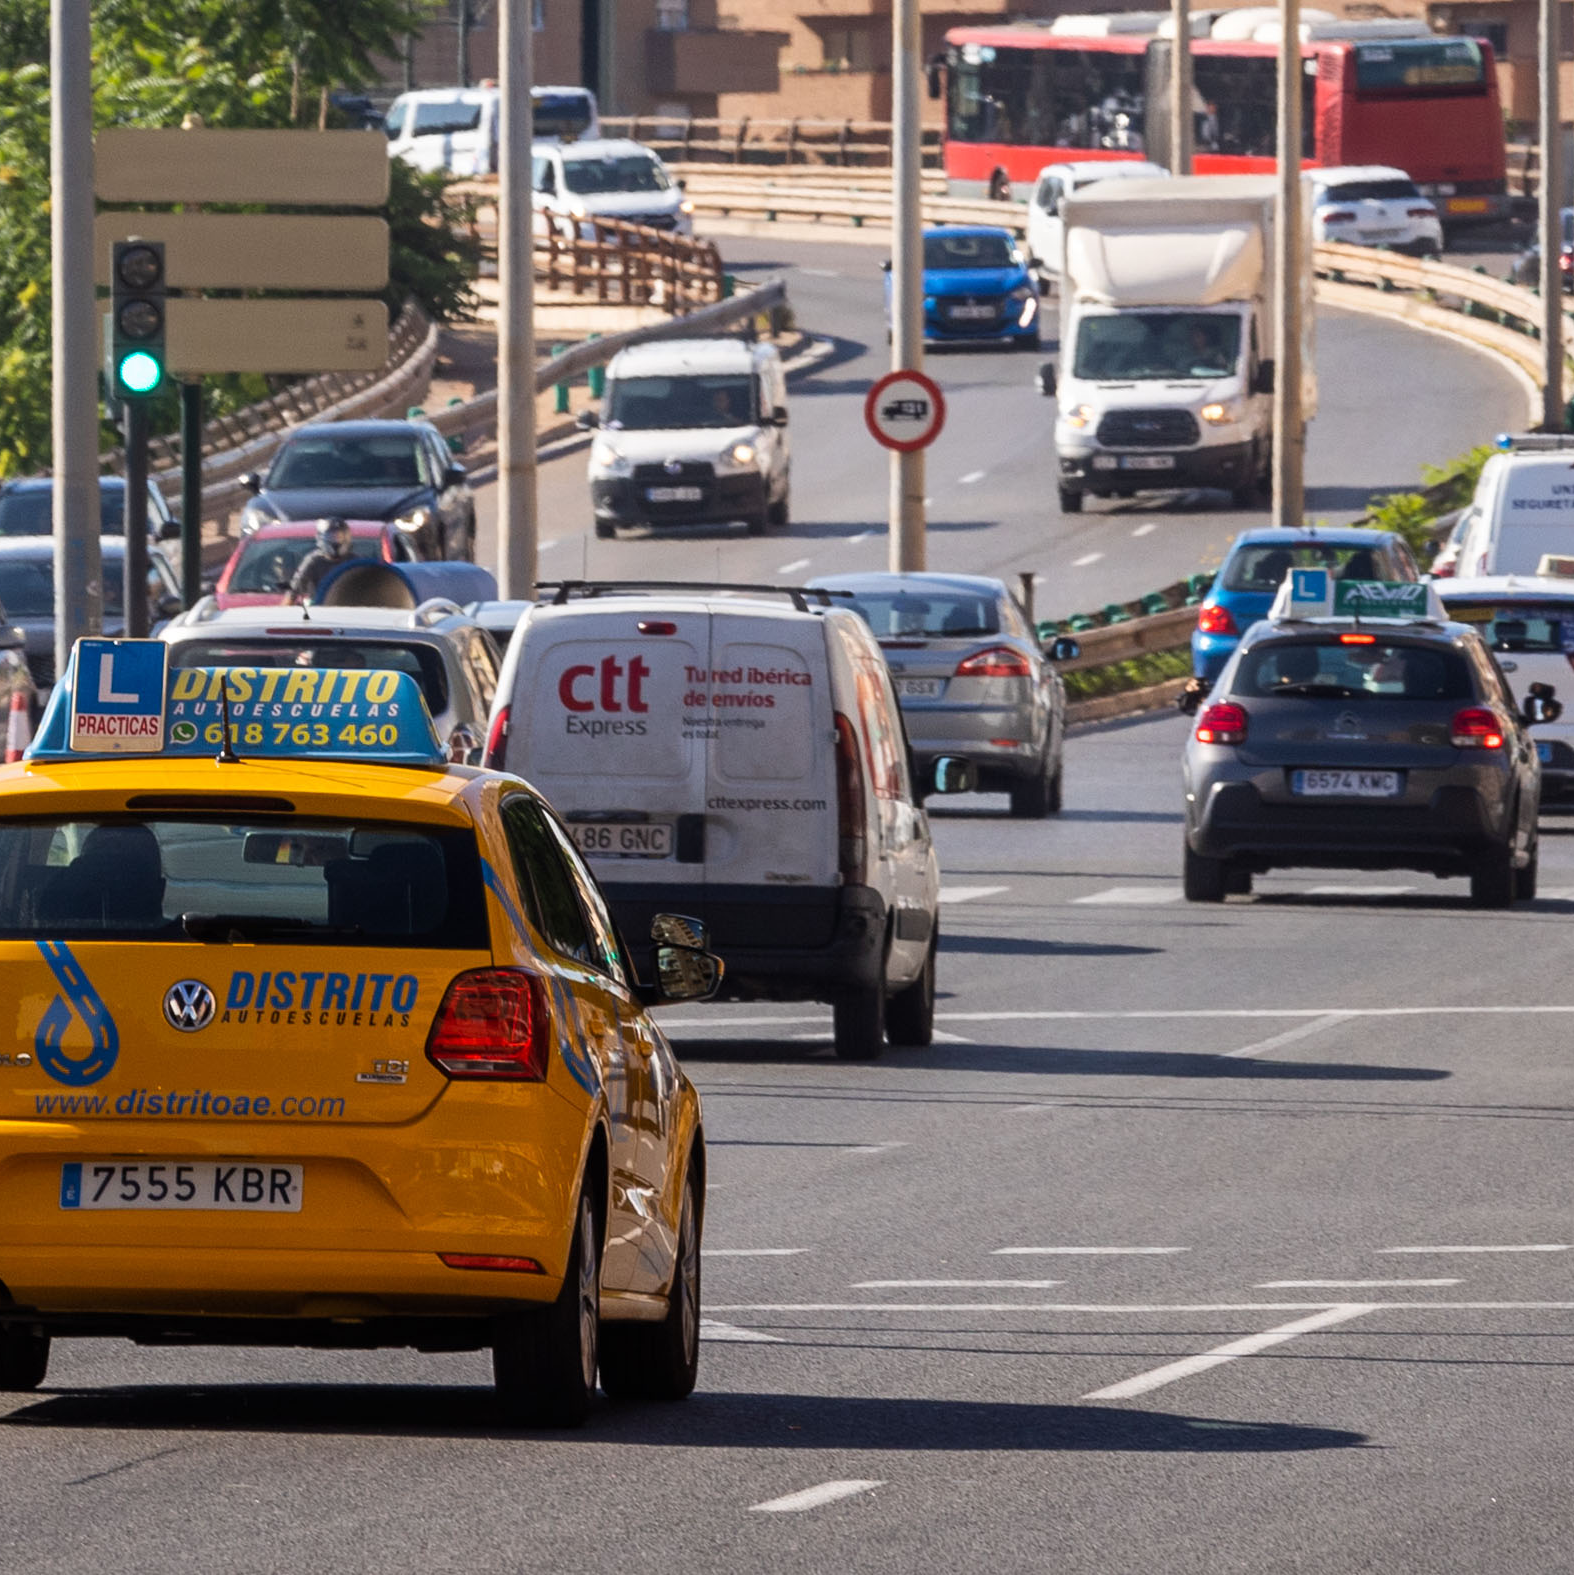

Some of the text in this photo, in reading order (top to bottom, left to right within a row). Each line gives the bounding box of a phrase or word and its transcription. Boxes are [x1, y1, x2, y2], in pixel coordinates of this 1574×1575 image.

[1298, 575, 1316, 597] L
[98, 653, 139, 703] L
[171, 667, 400, 704] DISTRITO
[558, 654, 650, 714] ctt
[684, 665, 813, 687] Tu red ibérica
[683, 690, 775, 708] de envíos
[173, 703, 400, 718] AUTOESCUELAS
[76, 714, 158, 737] PRACTICAS
[204, 723, 398, 746] 618 763 460
[566, 715, 647, 739] Express
[1306, 773, 1353, 788] 6574
[707, 796, 826, 812] cttexpress.com
[620, 828, 664, 850] GNC
[226, 971, 419, 1014] DISTRITO
[220, 1009, 411, 1028] AUTOESCUELAS
[371, 1059, 410, 1074] TDI
[34, 1089, 346, 1118] www.distritoae.com
[92, 1166, 293, 1205] 7555 KBR
